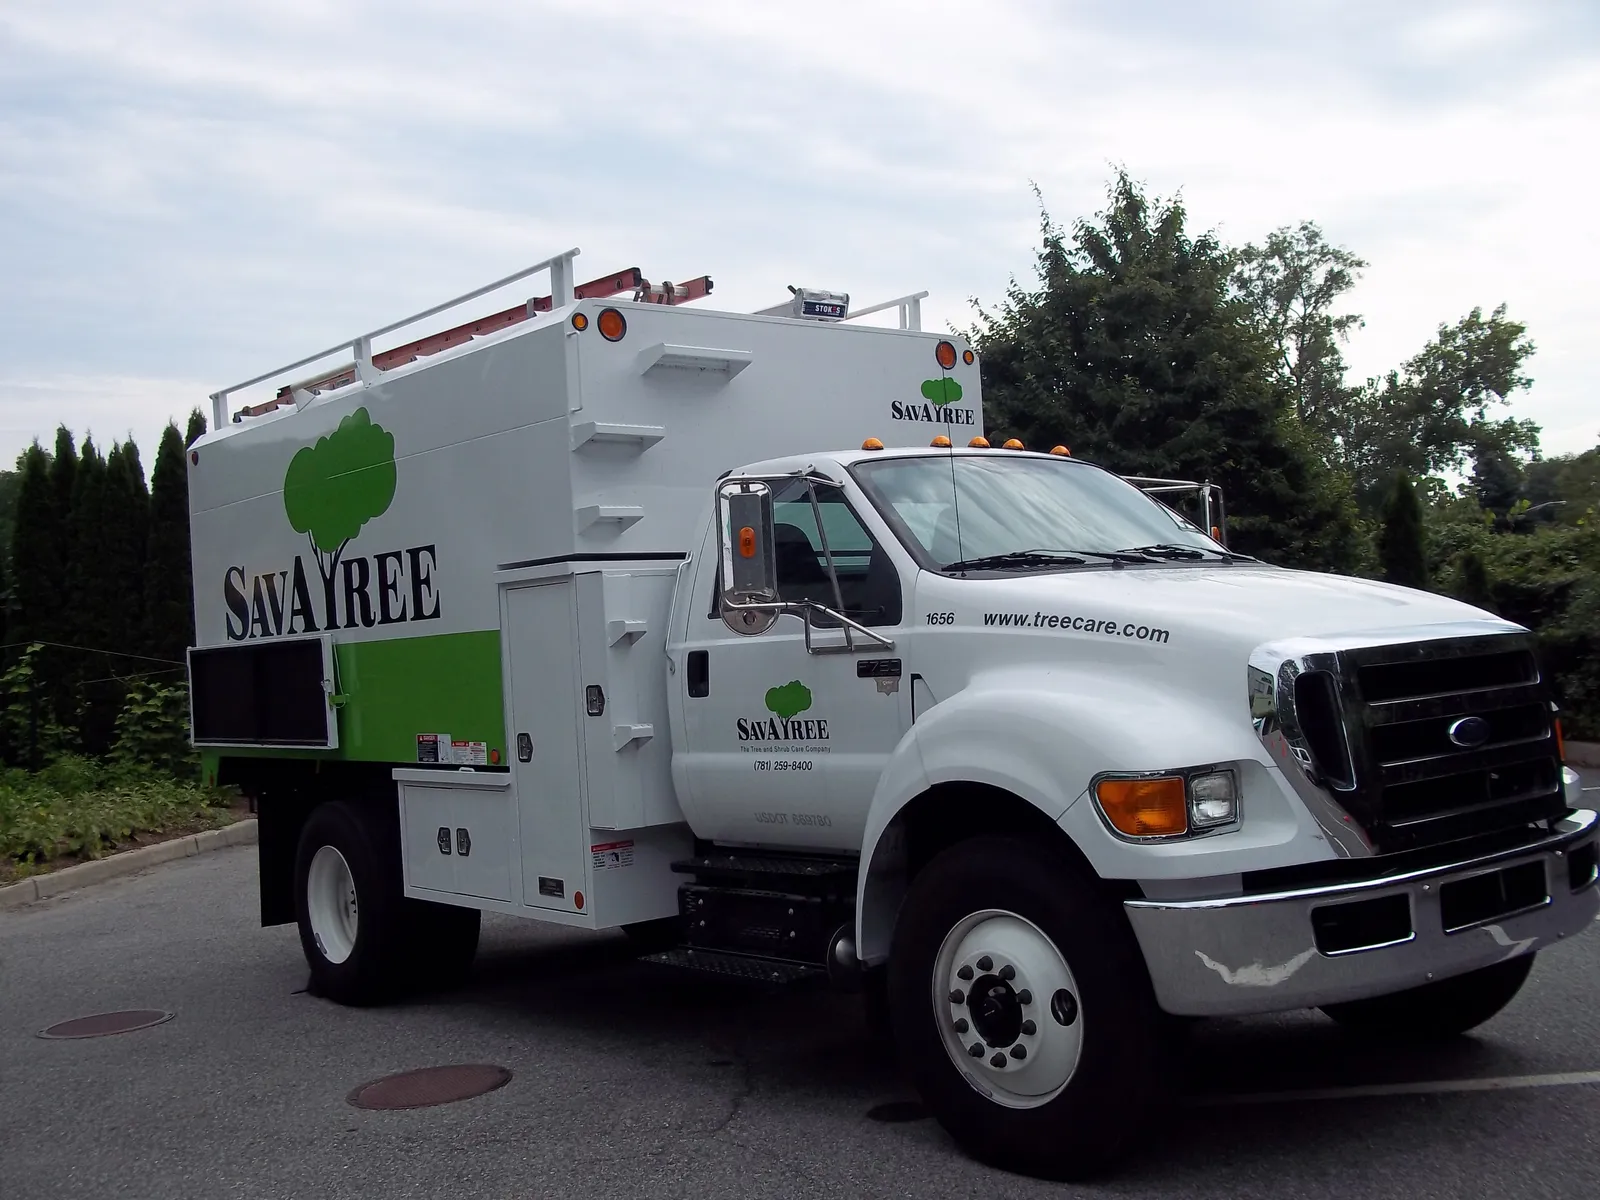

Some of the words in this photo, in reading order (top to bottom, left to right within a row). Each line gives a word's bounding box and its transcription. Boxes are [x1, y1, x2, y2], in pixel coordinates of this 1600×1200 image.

[815, 304, 841, 314] STOKES
[926, 612, 955, 625] 1656
[984, 611, 1170, 643] www.treecare.com
[806, 745, 831, 753] Company
[754, 760, 771, 771] (781)
[774, 760, 813, 771] 259-8400
[754, 812, 788, 824] USDOT
